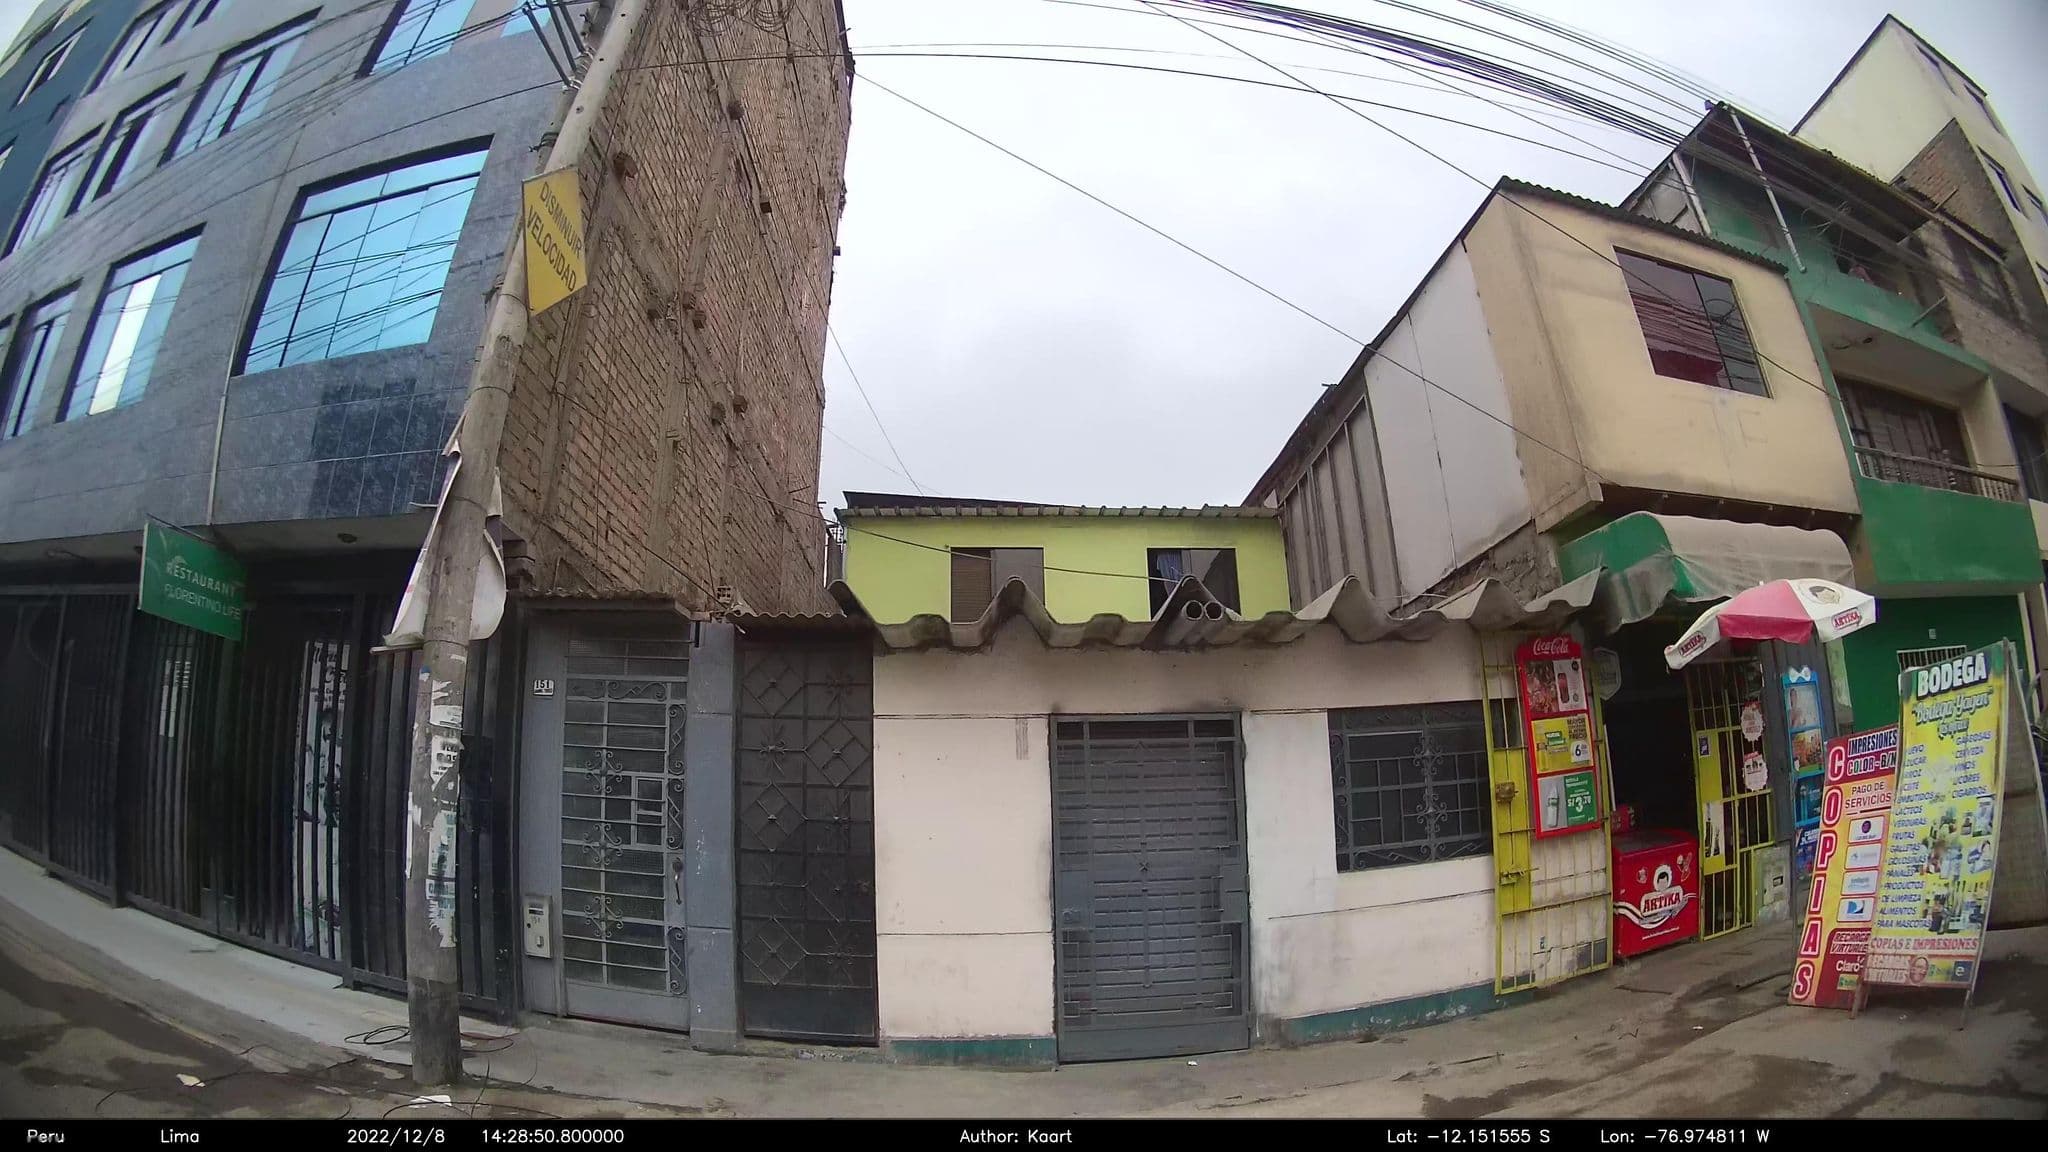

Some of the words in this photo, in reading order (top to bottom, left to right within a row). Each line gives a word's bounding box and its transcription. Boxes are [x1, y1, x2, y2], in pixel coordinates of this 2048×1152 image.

[540, 181, 583, 259] DISMINUIR
[526, 205, 577, 292] VELOCIDAD
[166, 560, 237, 597] RESTAURANT
[536, 679, 549, 689] 151
[1917, 652, 1988, 698] BODEGA
[1848, 728, 1897, 757] IMPRESIONES
[1847, 756, 1874, 776] COLOR
[1852, 784, 1873, 796] PAGO
[1875, 780, 1885, 792] DE
[1845, 792, 1892, 809] SERVICIOS
[1792, 745, 1846, 999] COPIAS
[1643, 892, 1681, 913] ARTIKA
[1879, 906, 1918, 916] ALIMENTOS
[1871, 936, 1904, 950] COPIAS
[1912, 937, 1980, 951] IMPRESIONES
[1836, 958, 1861, 972] Claro
